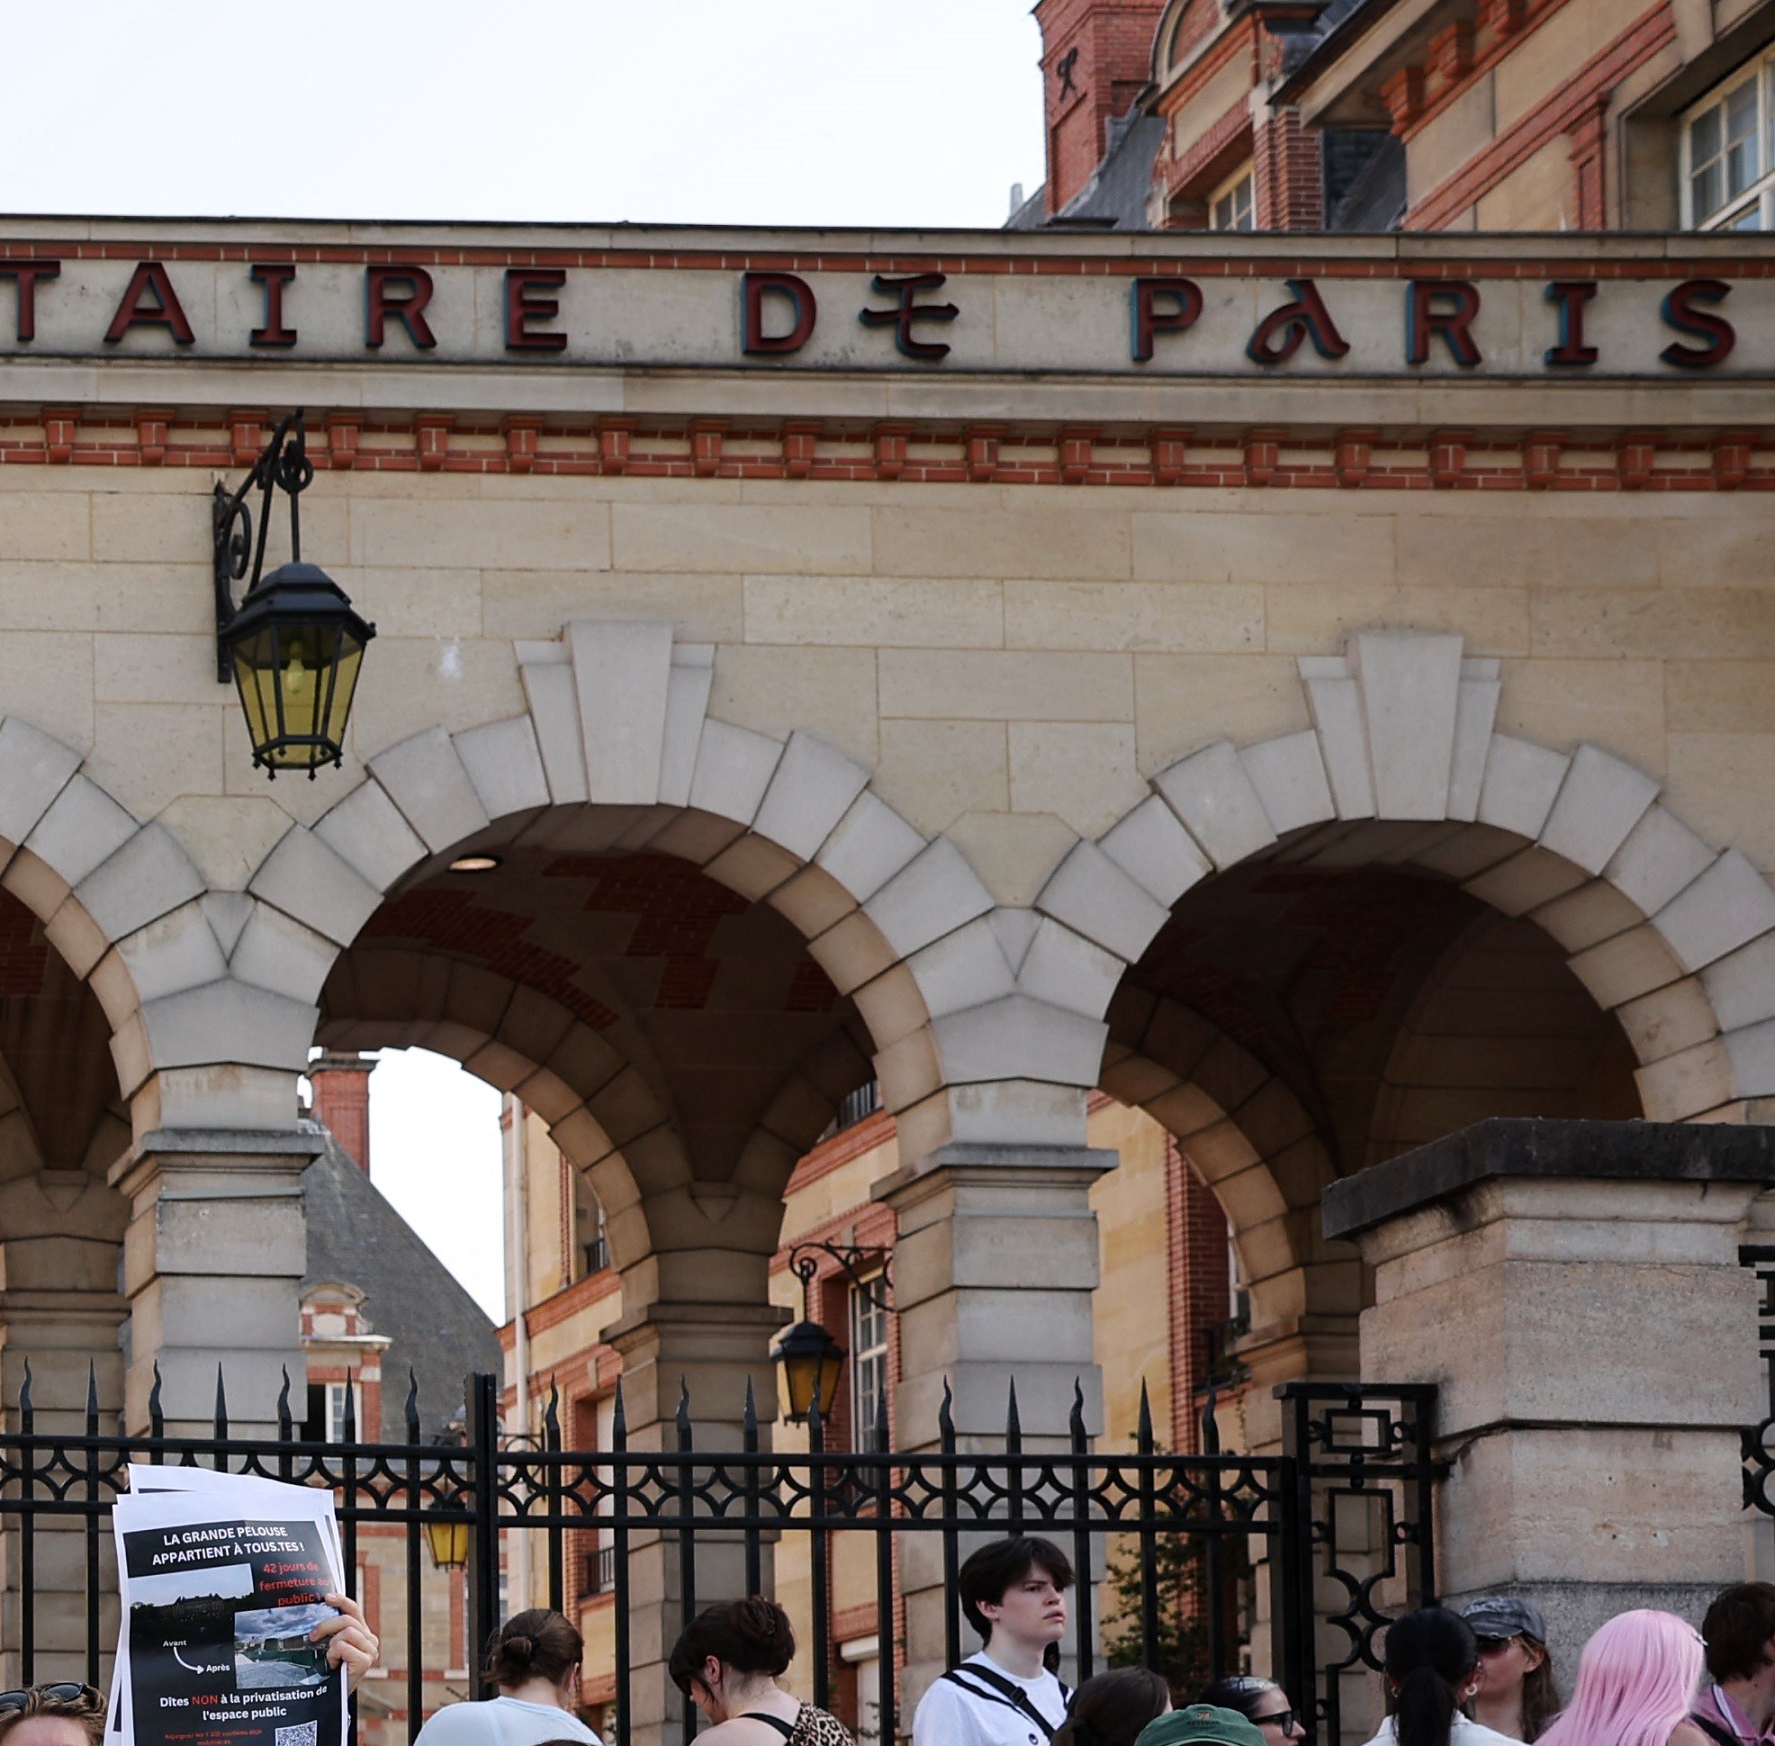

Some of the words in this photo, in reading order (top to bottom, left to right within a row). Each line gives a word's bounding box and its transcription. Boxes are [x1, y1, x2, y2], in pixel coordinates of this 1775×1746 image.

[163, 1534, 181, 1546] LA
[182, 1527, 235, 1544] GRANDE
[238, 1526, 289, 1538] PELOUSE
[152, 1545, 231, 1566] APPARTIENT
[234, 1542, 244, 1556] À
[263, 1563, 277, 1574] 42
[278, 1562, 305, 1576] jours
[259, 1577, 316, 1592] fermeture
[277, 1592, 314, 1608] public
[205, 1664, 231, 1674] Après
[191, 1695, 218, 1705] NON
[220, 1693, 228, 1705] à
[230, 1693, 240, 1704] la
[243, 1689, 314, 1705] privatisation
[315, 1685, 328, 1696] de
[202, 1710, 249, 1721] l'espace
[251, 1706, 287, 1721] public
